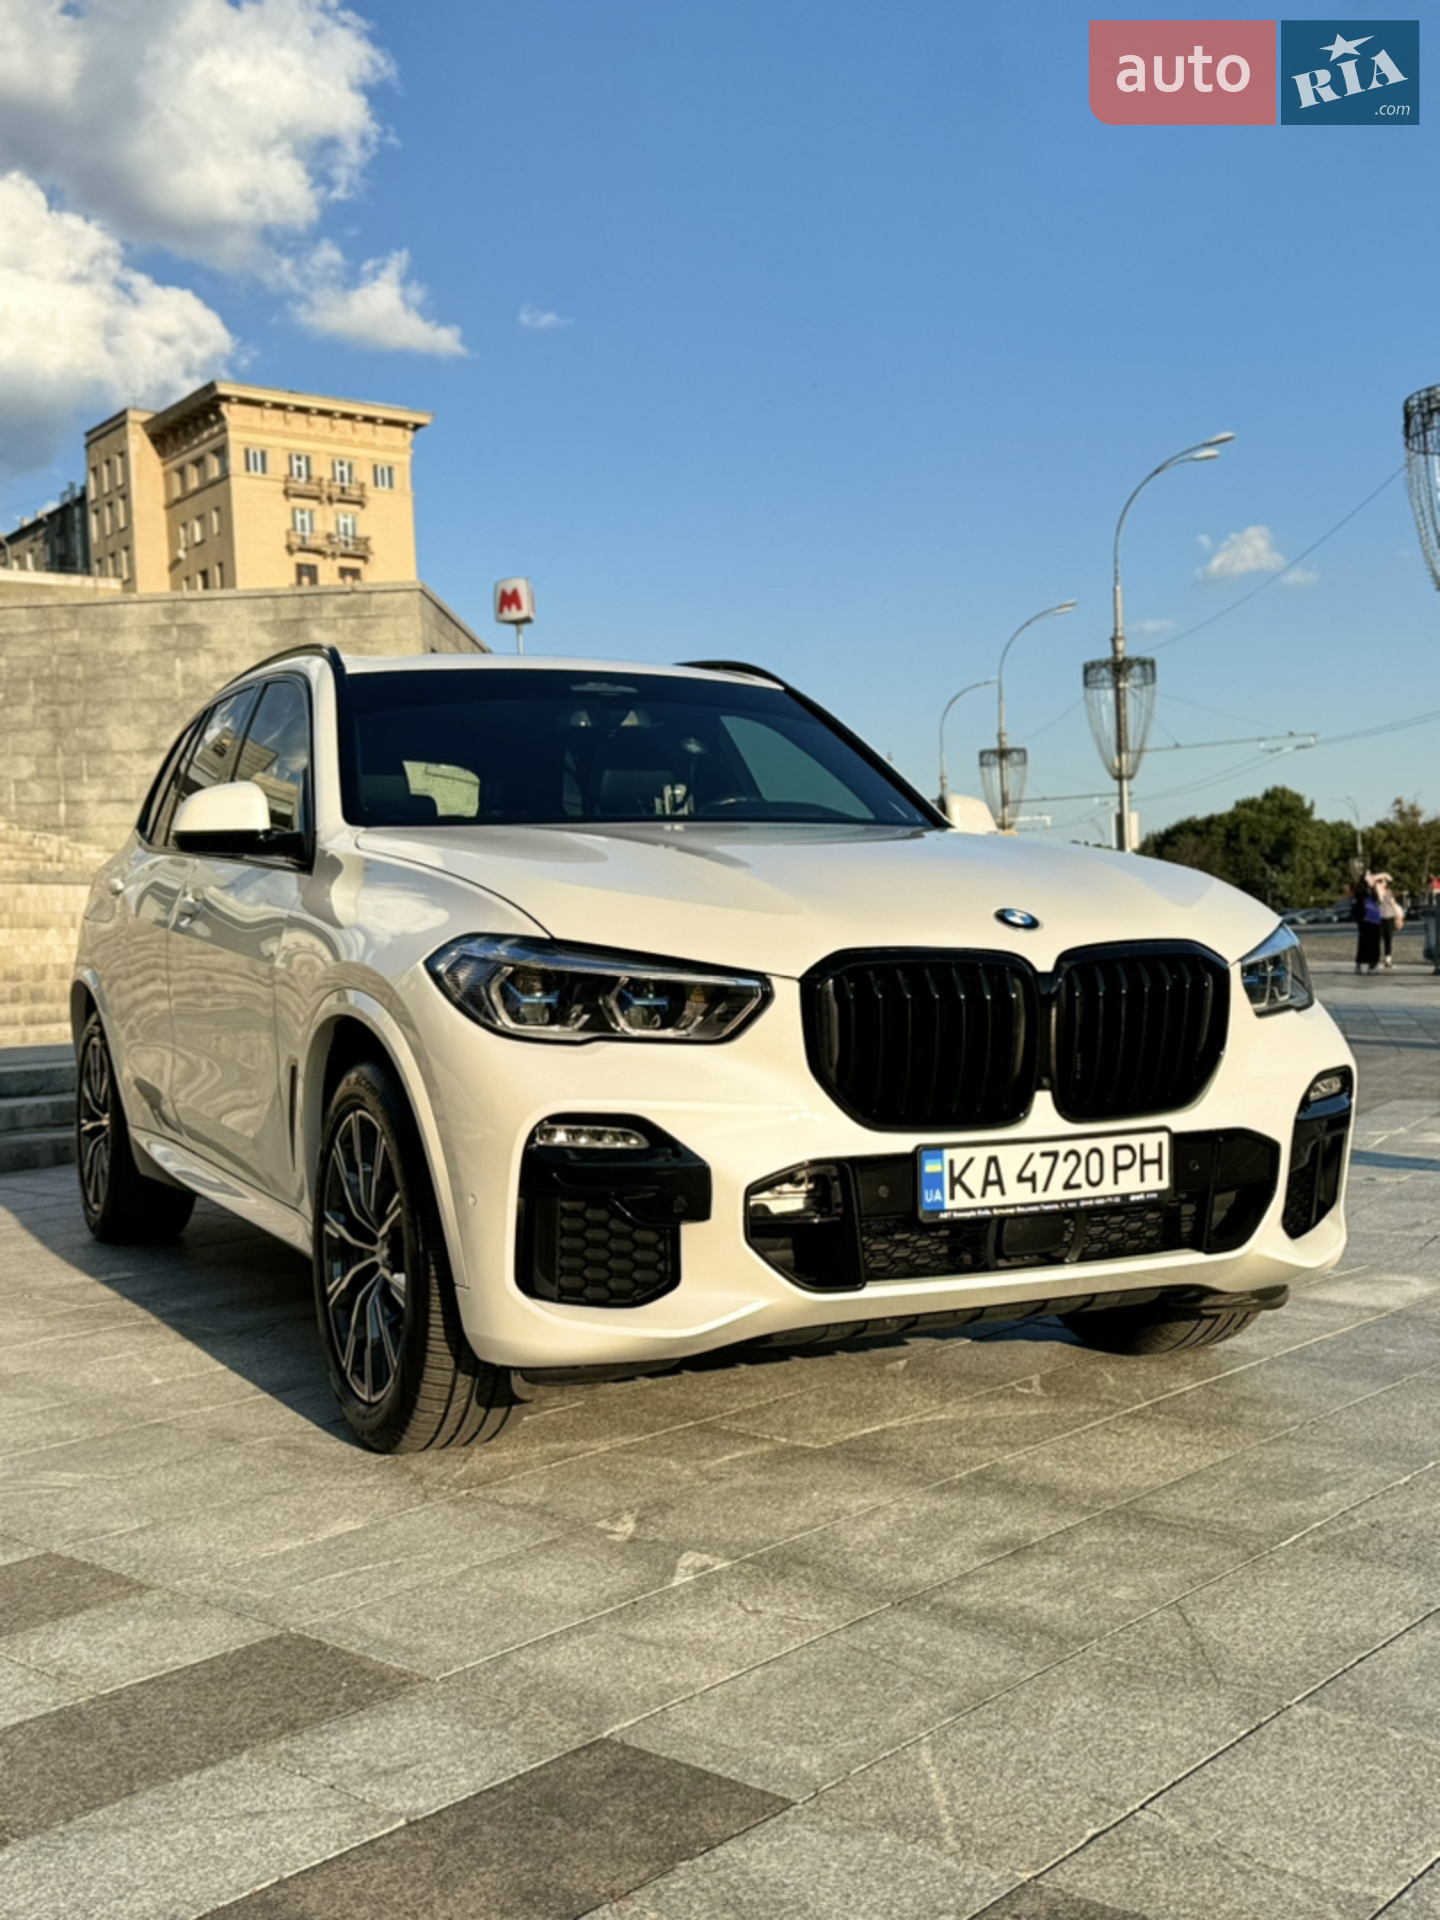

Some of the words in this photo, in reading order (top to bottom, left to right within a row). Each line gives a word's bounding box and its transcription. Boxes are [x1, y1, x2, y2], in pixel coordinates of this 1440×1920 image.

[498, 586, 523, 614] M
[948, 1155, 1007, 1201] KA
[1016, 1147, 1104, 1194] 4720
[1113, 1141, 1163, 1185] PH
[924, 1189, 943, 1203] UA
